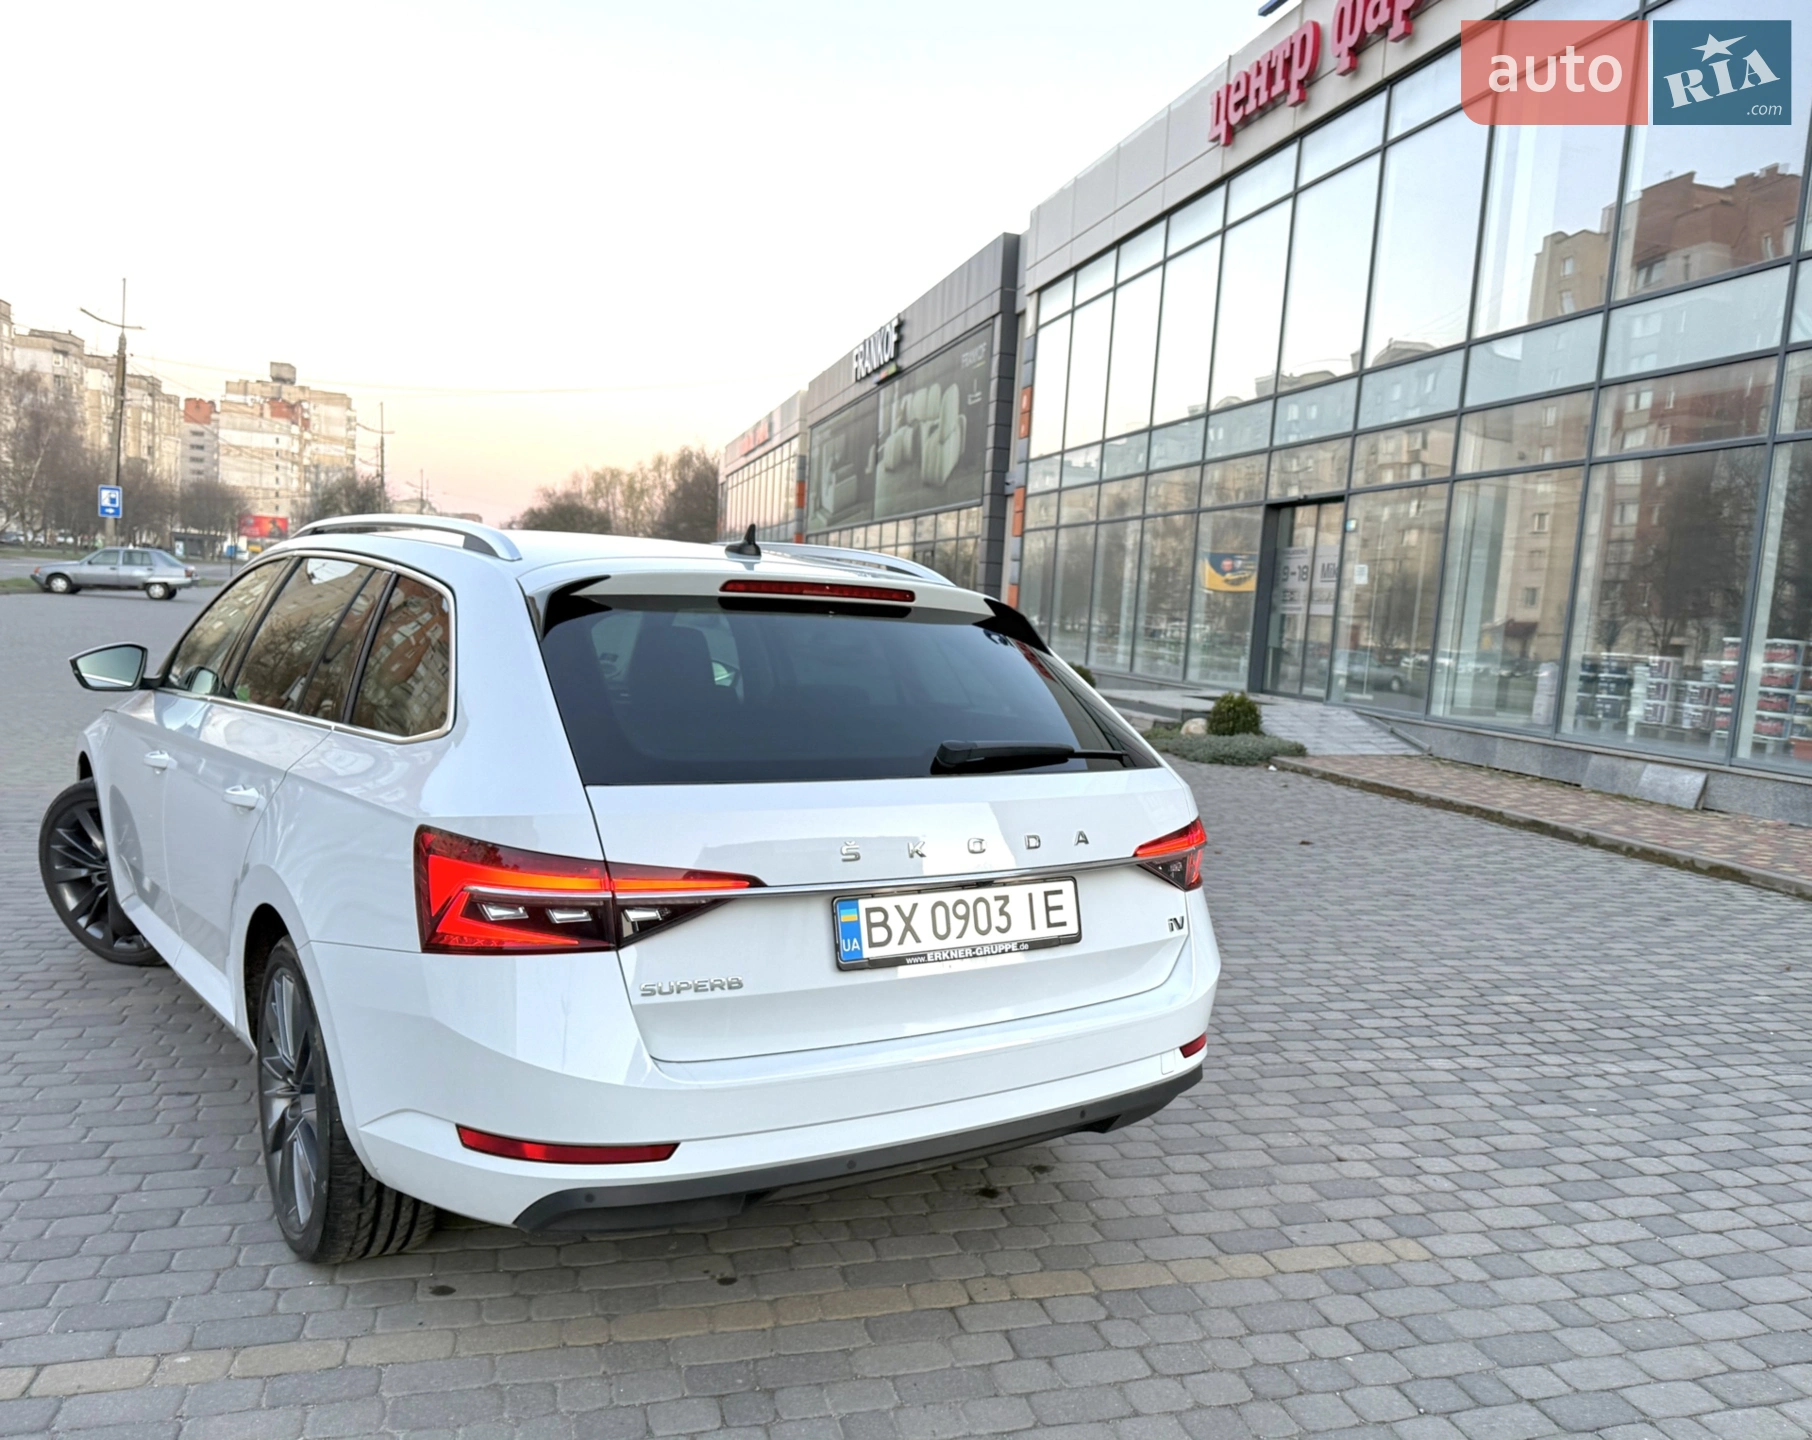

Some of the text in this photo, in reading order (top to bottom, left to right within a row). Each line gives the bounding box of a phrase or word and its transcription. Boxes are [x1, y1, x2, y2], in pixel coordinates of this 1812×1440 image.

[1208, 19, 1320, 146] центр
[852, 316, 900, 383] FRANKOF
[840, 830, 1090, 863] ŠKODA
[864, 888, 1068, 949] BX 0903 IE
[1168, 915, 1185, 932] iV
[842, 937, 861, 952] UA
[905, 942, 1029, 965] www.ERKNER-GRUPPE.de
[640, 976, 744, 998] SUPERB
